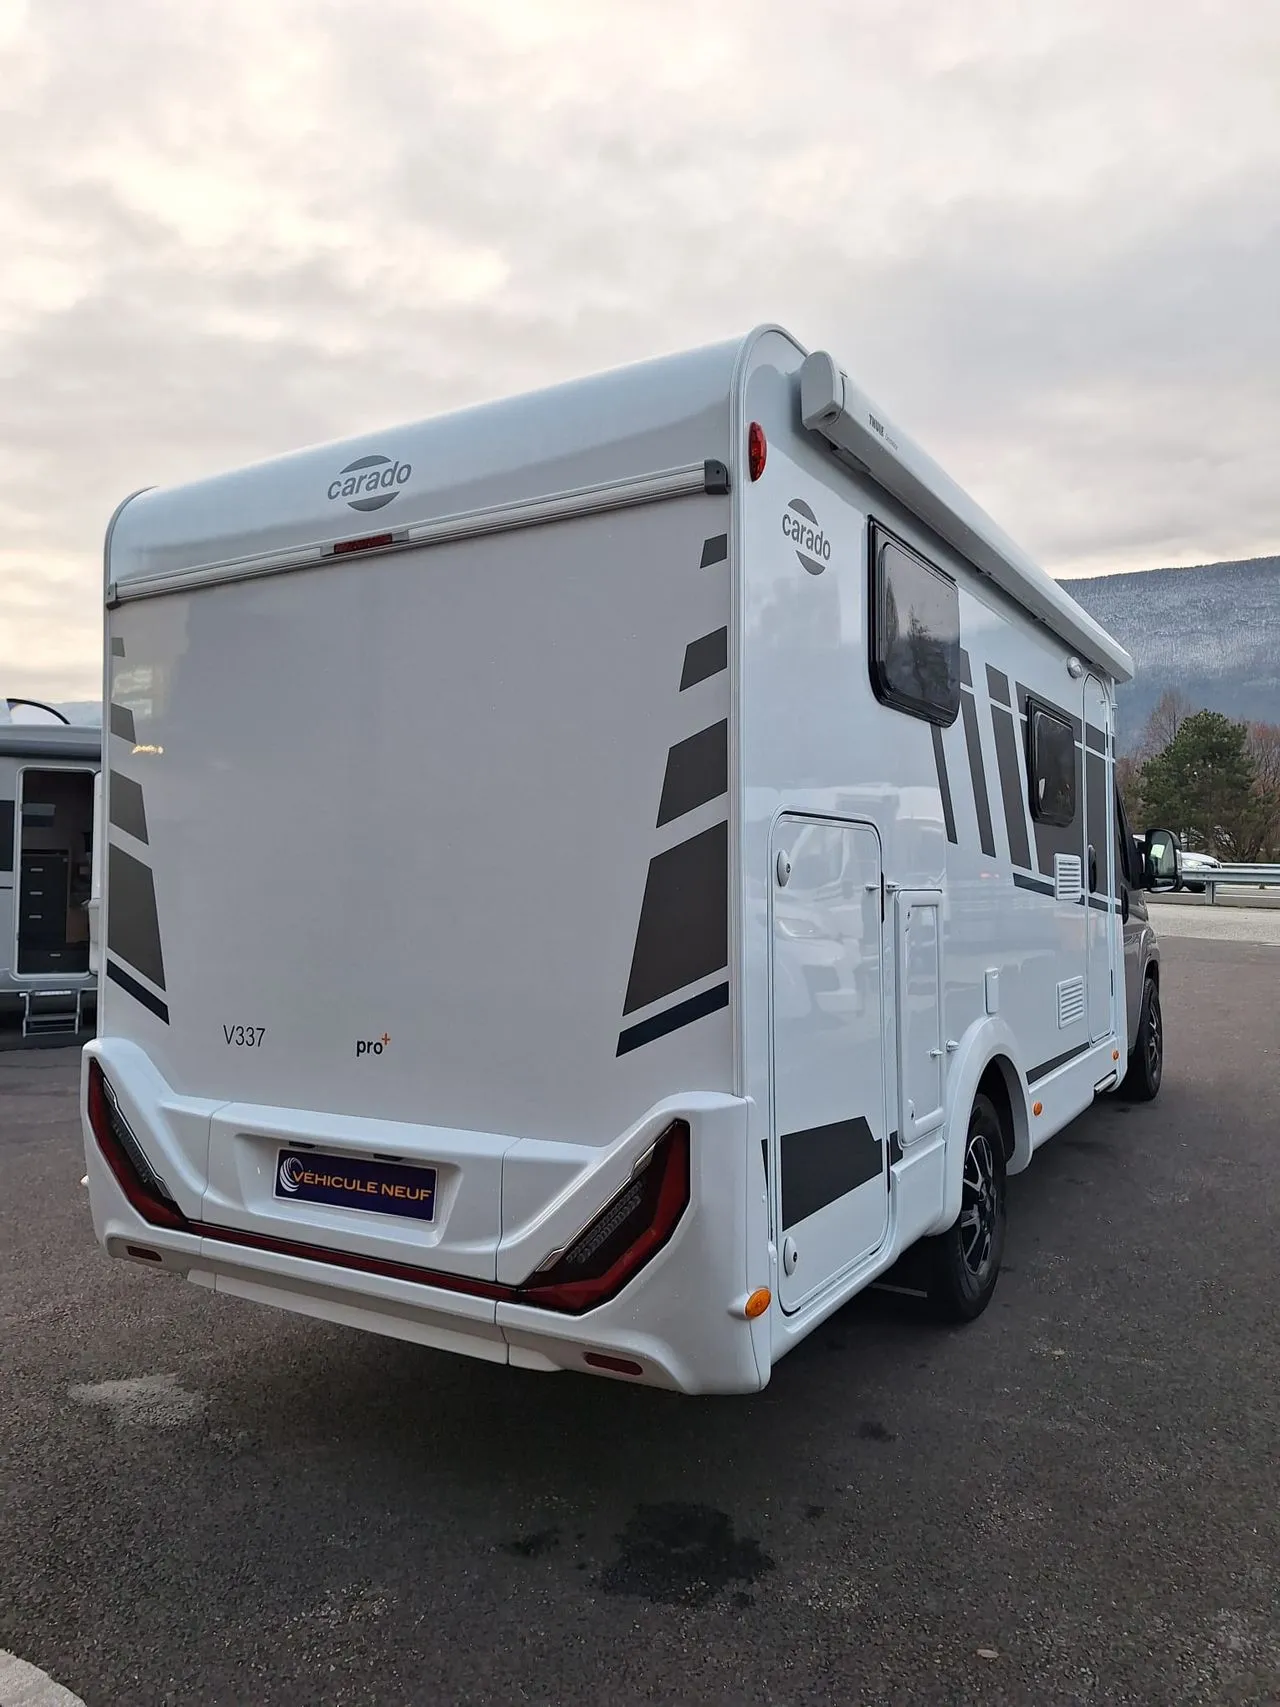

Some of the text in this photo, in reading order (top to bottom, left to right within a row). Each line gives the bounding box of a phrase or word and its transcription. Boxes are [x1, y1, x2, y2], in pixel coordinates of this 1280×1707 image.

[327, 460, 412, 500] carado
[782, 513, 831, 561] carado
[223, 1024, 266, 1048] V337
[292, 1169, 432, 1201] VÉHICULE NEUF
